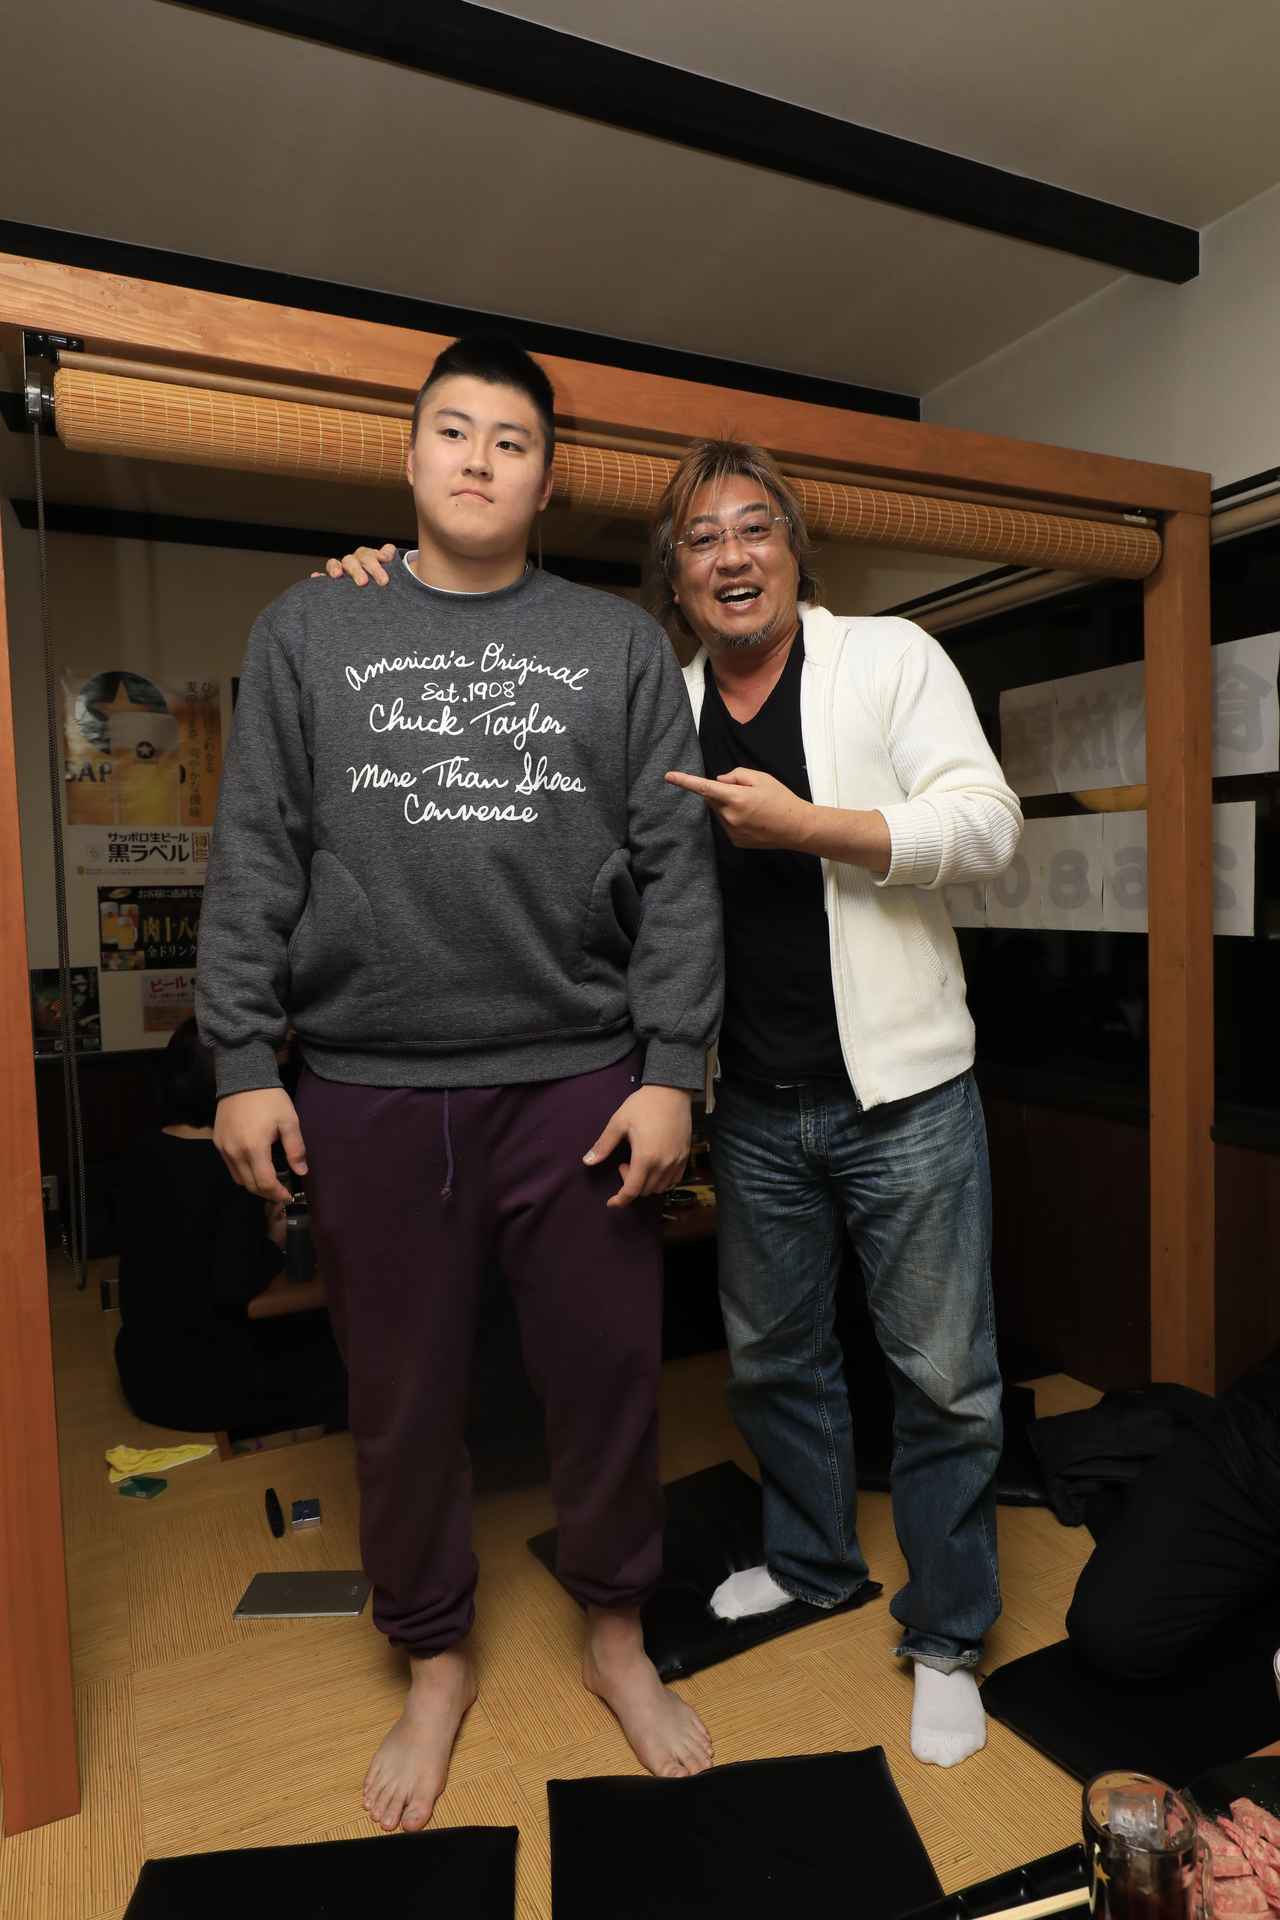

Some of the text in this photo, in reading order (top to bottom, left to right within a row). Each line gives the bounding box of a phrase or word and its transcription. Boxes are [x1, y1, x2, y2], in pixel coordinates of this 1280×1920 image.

[345, 642, 590, 692] America's Original
[369, 696, 567, 751] Chuck Taylor
[346, 751, 586, 796] More Than Shoes
[404, 793, 539, 825] Converse
[107, 832, 190, 843] サッポロ生ビール
[107, 843, 190, 863] 黒ラベル
